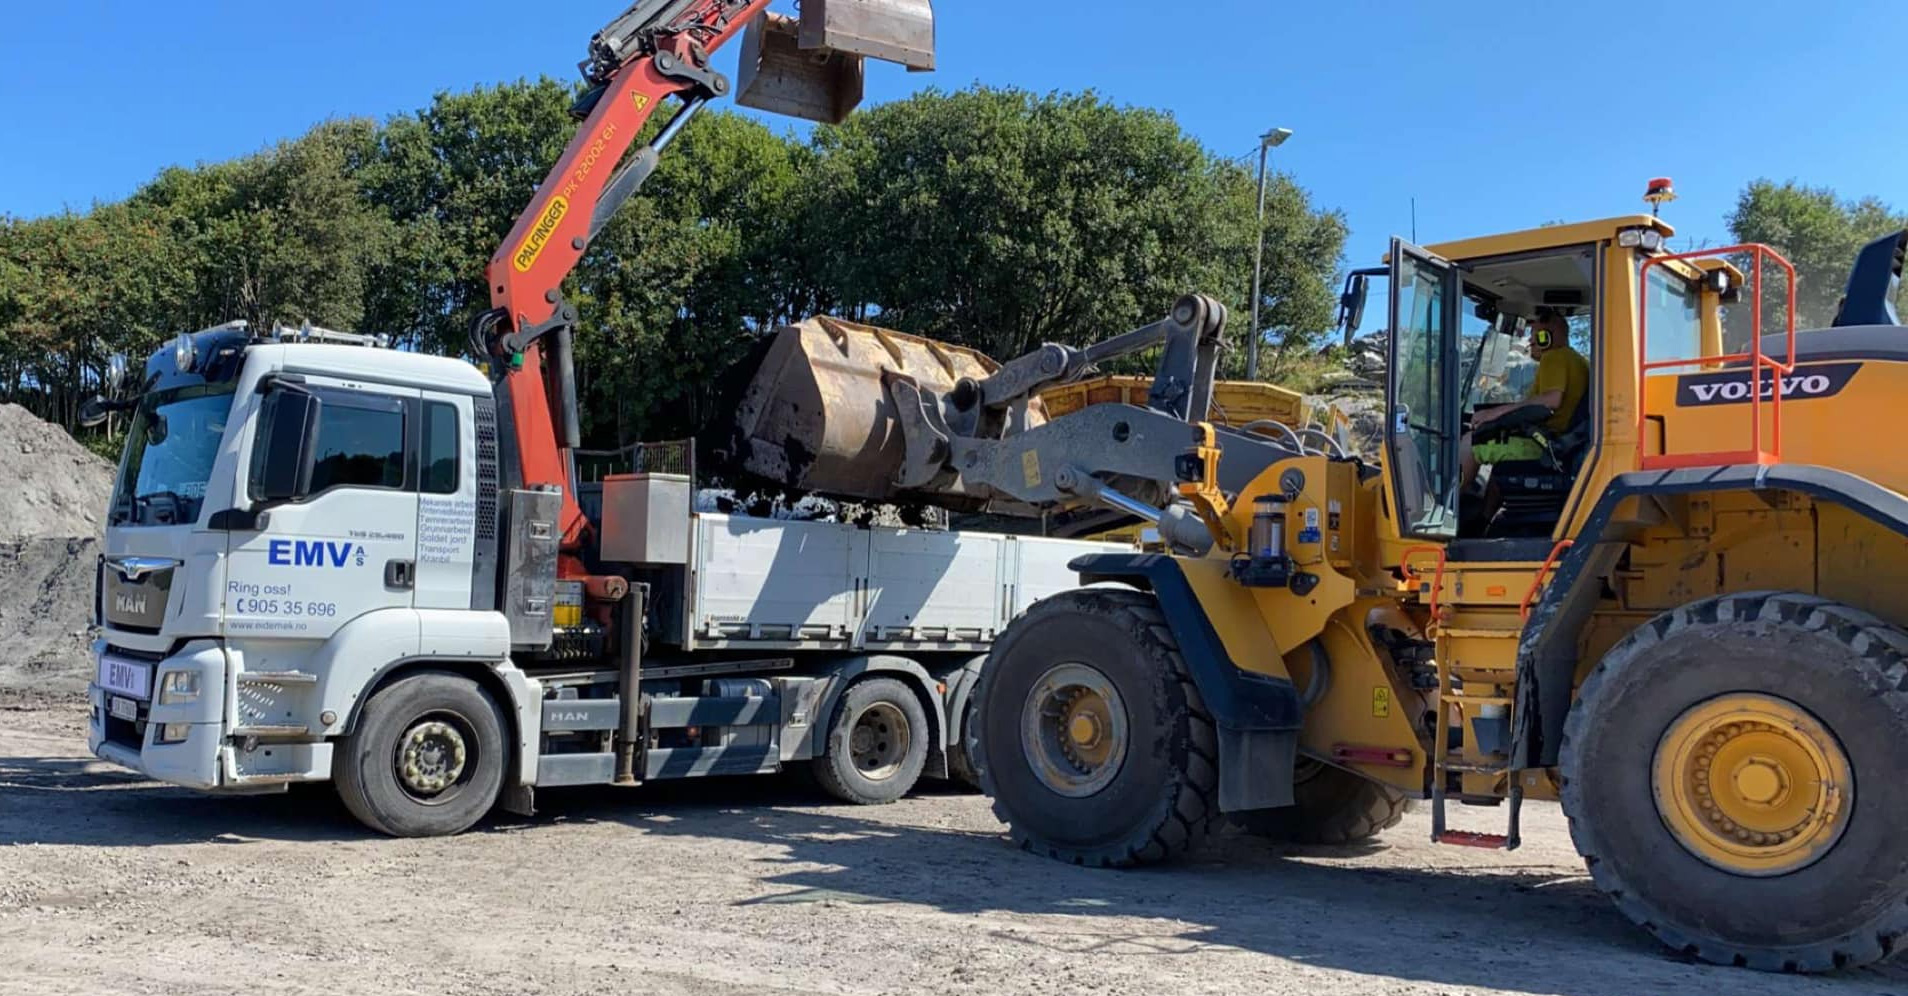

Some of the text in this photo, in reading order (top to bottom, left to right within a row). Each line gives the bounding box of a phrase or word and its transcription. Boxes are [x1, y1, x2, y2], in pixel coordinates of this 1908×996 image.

[517, 123, 618, 268] PALFINGER PK 22002 EH
[1689, 375, 1830, 401] VOLVO
[269, 539, 353, 568] EMV
[420, 543, 460, 553] Transport
[228, 580, 291, 596] Ring oss!
[115, 593, 148, 614] MAN
[248, 599, 337, 616] 905 35 696
[229, 620, 307, 631] www.eidemek.no
[109, 663, 132, 689] EMV
[551, 711, 588, 721] MAN
